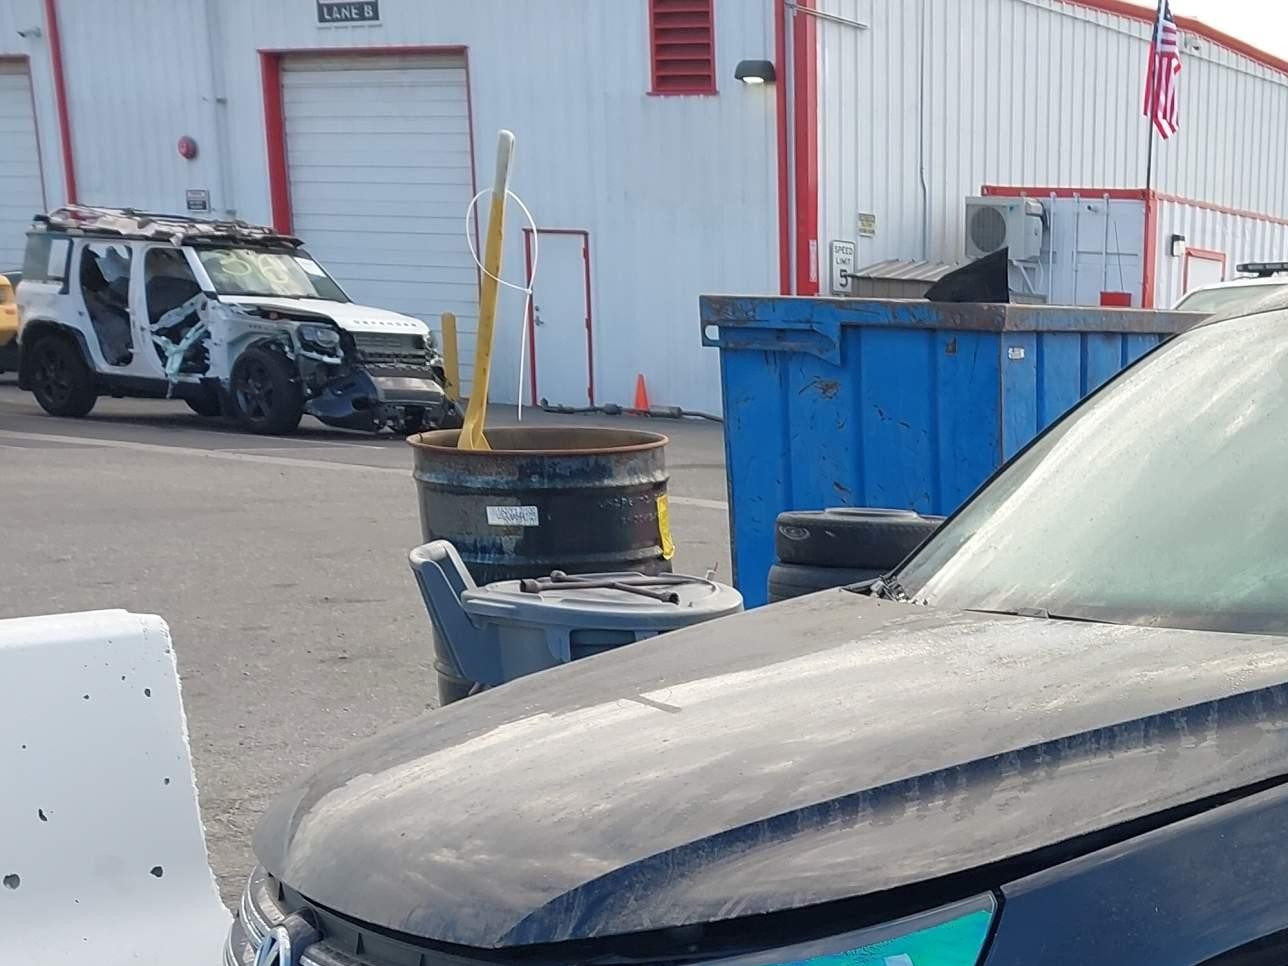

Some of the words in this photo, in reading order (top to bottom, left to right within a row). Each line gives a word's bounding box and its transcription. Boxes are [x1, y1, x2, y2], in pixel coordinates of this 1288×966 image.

[322, 5, 360, 20] LANE
[363, 4, 374, 17] B
[834, 245, 853, 256] SPEED
[835, 257, 851, 265] LIMIT
[839, 268, 849, 288] 5
